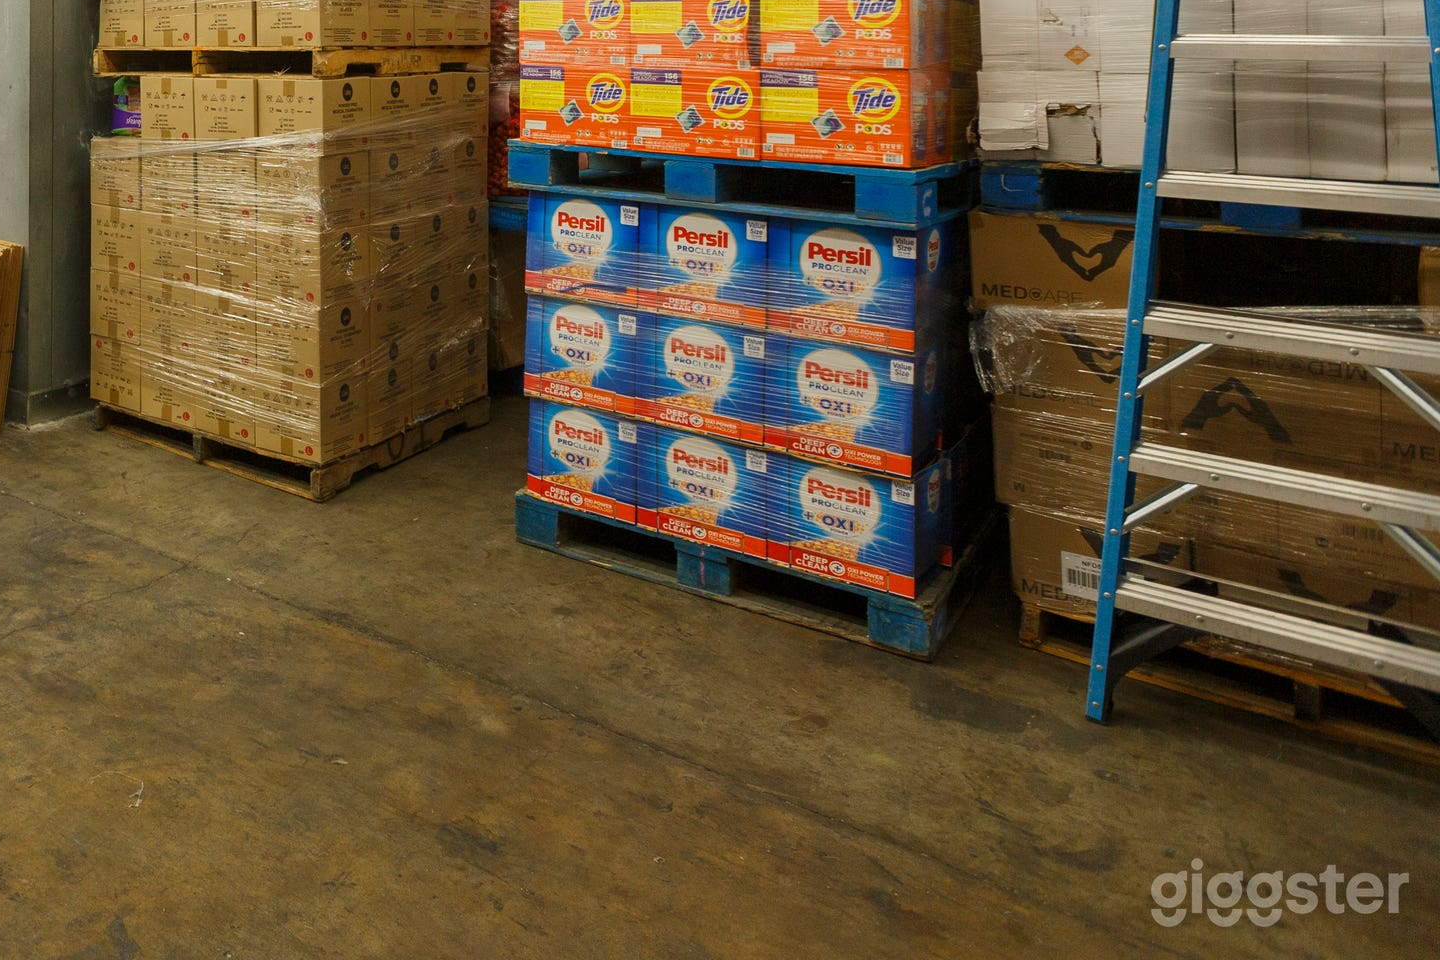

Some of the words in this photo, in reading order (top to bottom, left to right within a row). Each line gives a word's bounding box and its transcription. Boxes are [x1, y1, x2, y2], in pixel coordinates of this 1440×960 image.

[589, 0, 621, 22] Tide
[711, 0, 748, 25] Tide
[590, 83, 623, 105] Tide
[711, 86, 750, 111] Tide
[853, 88, 896, 115] Tide
[558, 212, 605, 232] Persil
[560, 229, 601, 240] PROCLEAN
[674, 226, 728, 248] Persil
[568, 244, 592, 255] OXI
[677, 245, 724, 256] PROCLEAN
[808, 242, 871, 266] Persil
[686, 260, 714, 272] OXI
[812, 263, 867, 275] PROCLEAN
[823, 278, 854, 291] OXI
[556, 316, 603, 339] Persil
[803, 318, 829, 326] DEEP
[796, 324, 829, 334] CLEAN
[559, 334, 599, 346] PROCLEAN
[566, 349, 590, 360] OXI
[671, 338, 725, 363] Persil
[674, 357, 721, 369] PROCLEAN
[683, 372, 710, 386] OXI
[806, 361, 868, 389] Persil
[545, 387, 569, 398] CLEAN
[550, 383, 569, 391] DEEP
[809, 382, 863, 398] PROCLEAN
[666, 408, 688, 417] DEEP
[820, 399, 851, 413] OXI
[660, 413, 688, 424] CLEAN
[555, 420, 602, 445] Persil
[558, 438, 599, 452] PROCLEAN
[793, 443, 825, 454] CLEAN
[800, 438, 825, 447] DEEP
[566, 453, 589, 466] OXI
[673, 449, 728, 475] Persil
[858, 452, 881, 460] POWER
[545, 491, 569, 502] CLEAN
[550, 486, 569, 496] DEEP
[686, 483, 714, 497] OXI
[808, 478, 870, 507] Persil
[812, 498, 866, 516] PROCLEAN
[663, 523, 691, 535] CLEAN
[669, 519, 691, 528] DEEP
[823, 515, 853, 531] OXI
[795, 559, 828, 572] CLEAN
[803, 554, 828, 564] DEEP
[860, 571, 884, 580] POWER
